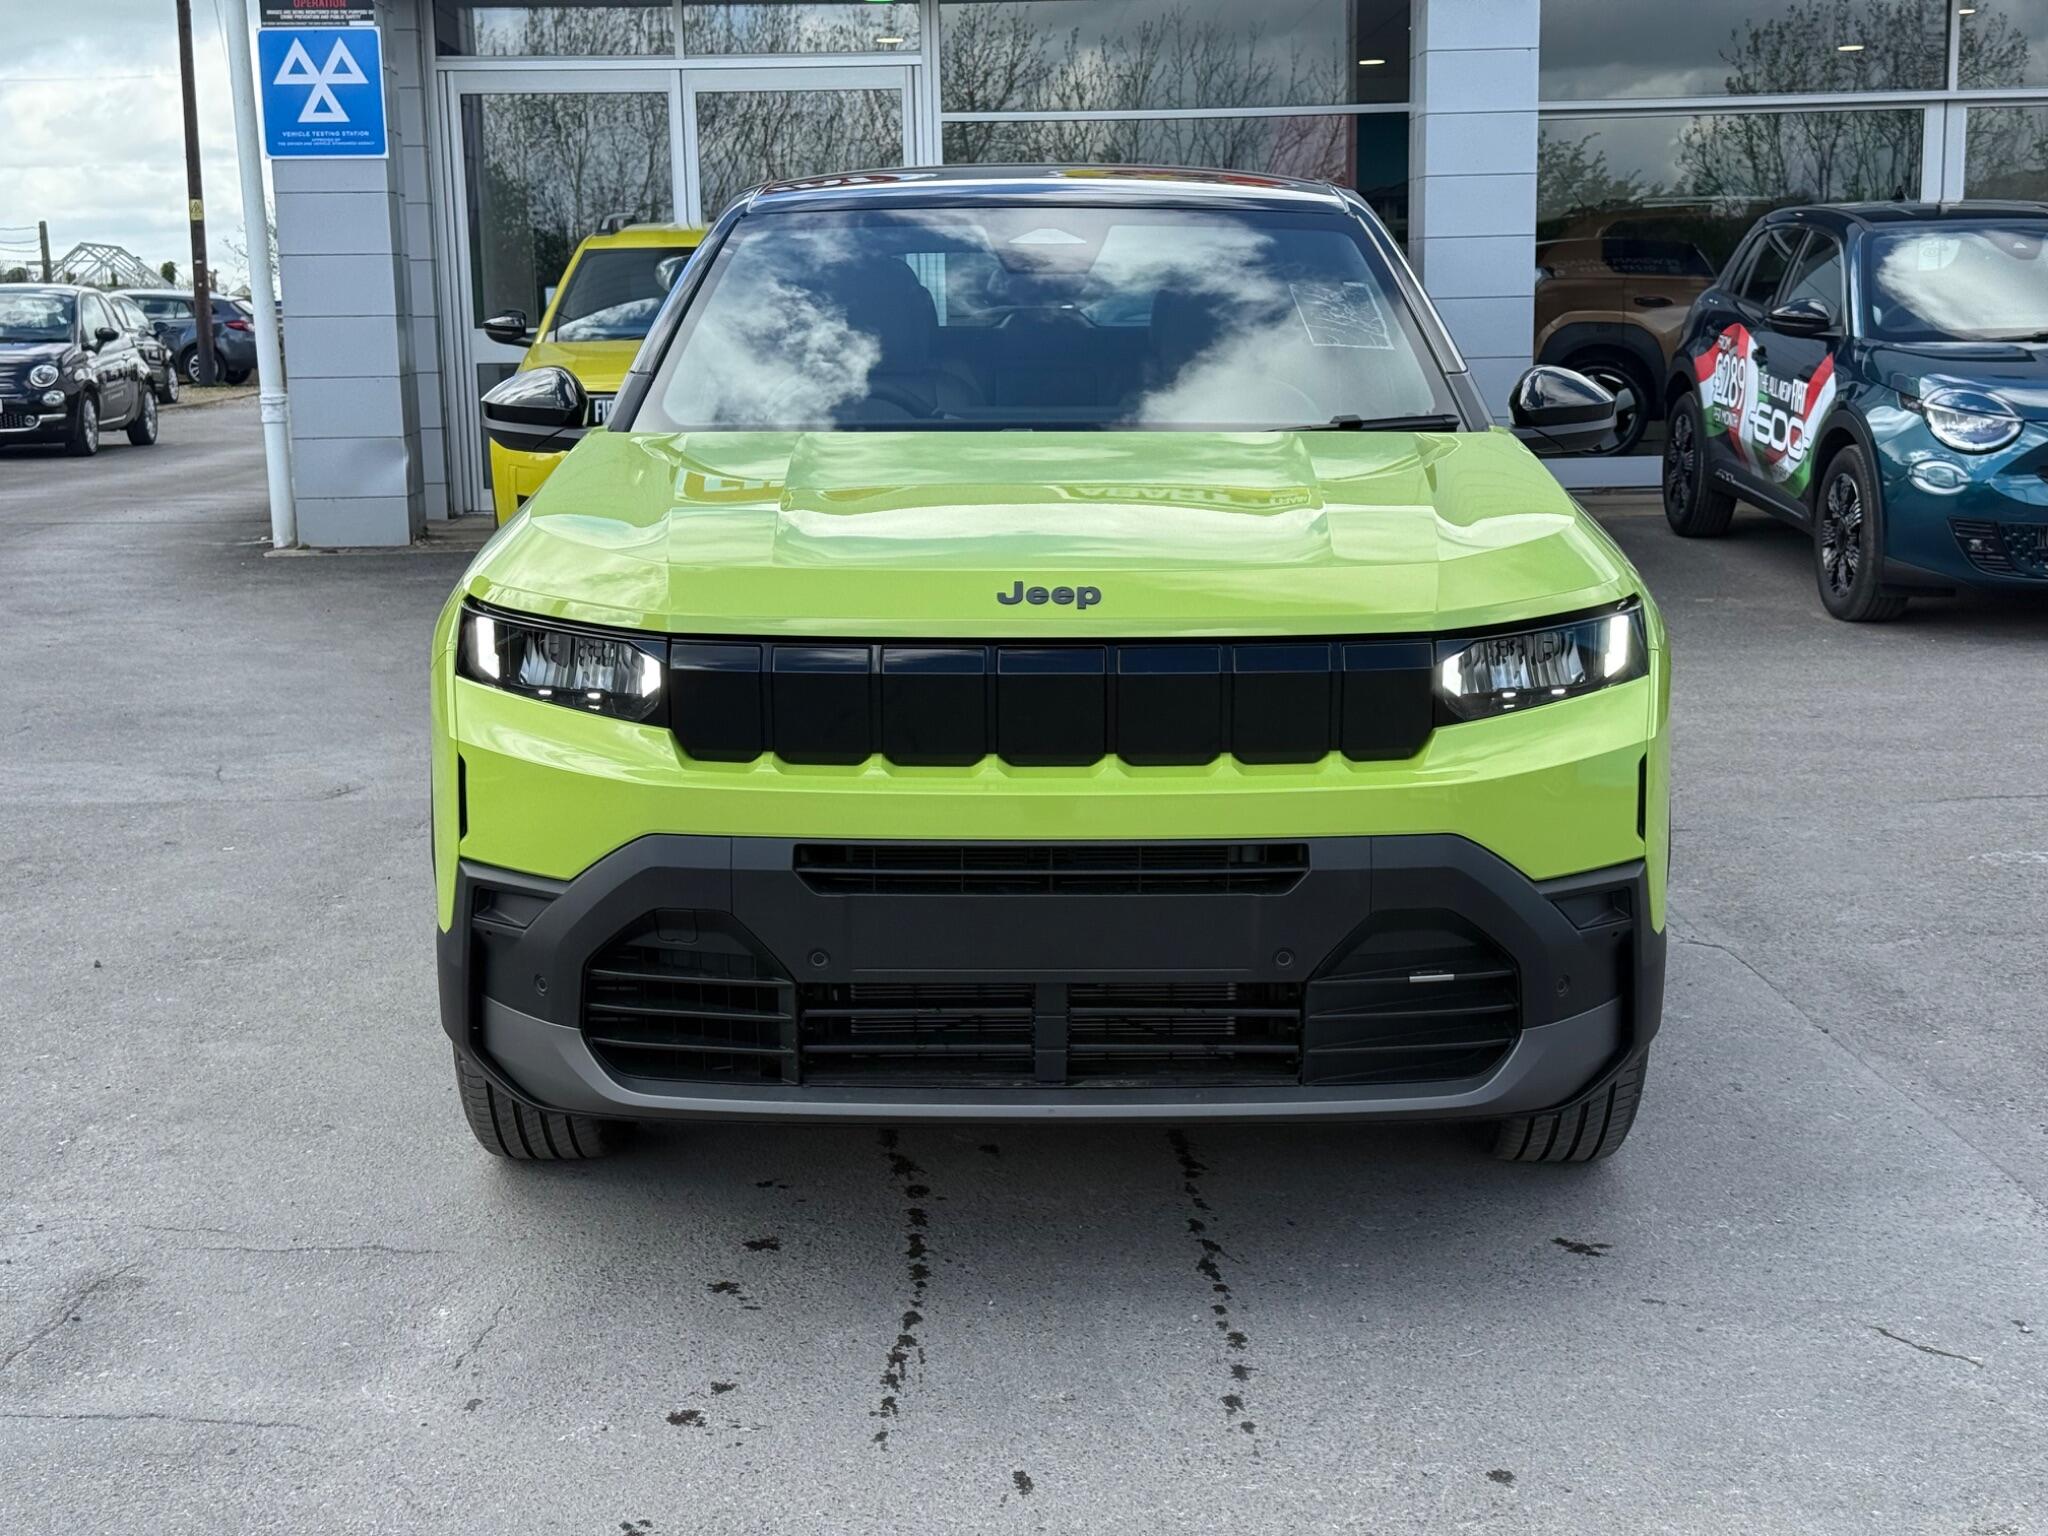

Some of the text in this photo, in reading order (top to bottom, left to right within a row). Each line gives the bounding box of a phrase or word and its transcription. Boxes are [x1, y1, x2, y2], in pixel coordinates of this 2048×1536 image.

[594, 400, 615, 422] FI
[1754, 401, 1805, 461] 600
[997, 580, 1102, 610] Jeep
